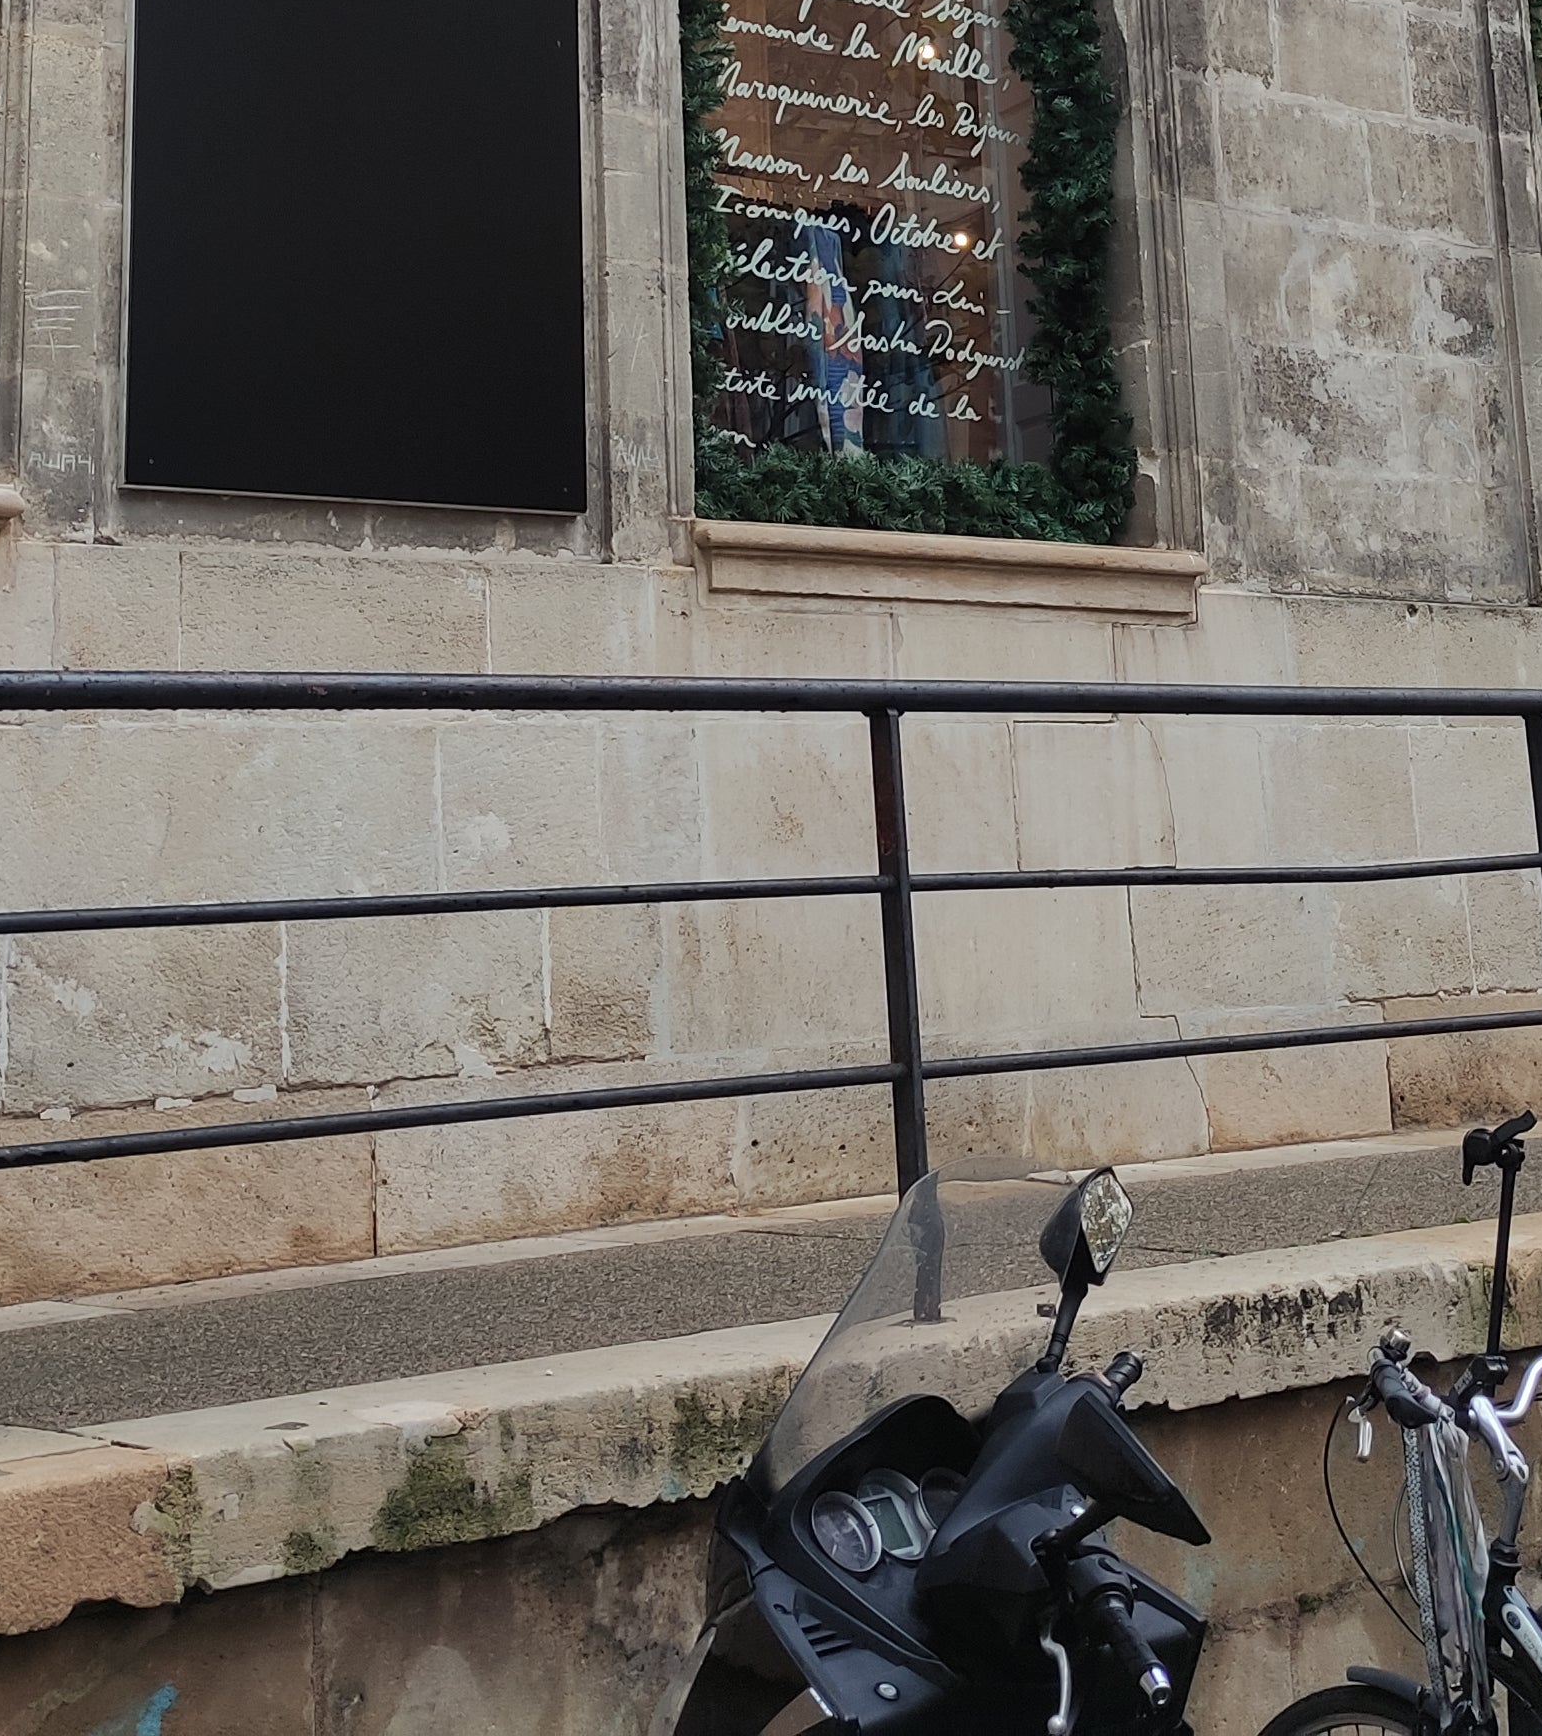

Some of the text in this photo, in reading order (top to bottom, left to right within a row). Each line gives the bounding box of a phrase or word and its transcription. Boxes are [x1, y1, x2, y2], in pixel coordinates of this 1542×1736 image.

[716, 2, 835, 52] emande
[842, 23, 881, 59] la
[907, 93, 946, 130] les
[828, 153, 869, 184] les
[877, 151, 1001, 214] Souliers,
[870, 204, 960, 254] Octobre
[972, 227, 1005, 262] et
[724, 238, 858, 294] élection
[861, 279, 923, 304] pour
[725, 302, 823, 341] oublier
[828, 311, 922, 354] Sasha
[716, 367, 982, 422] tiste invitée de la
